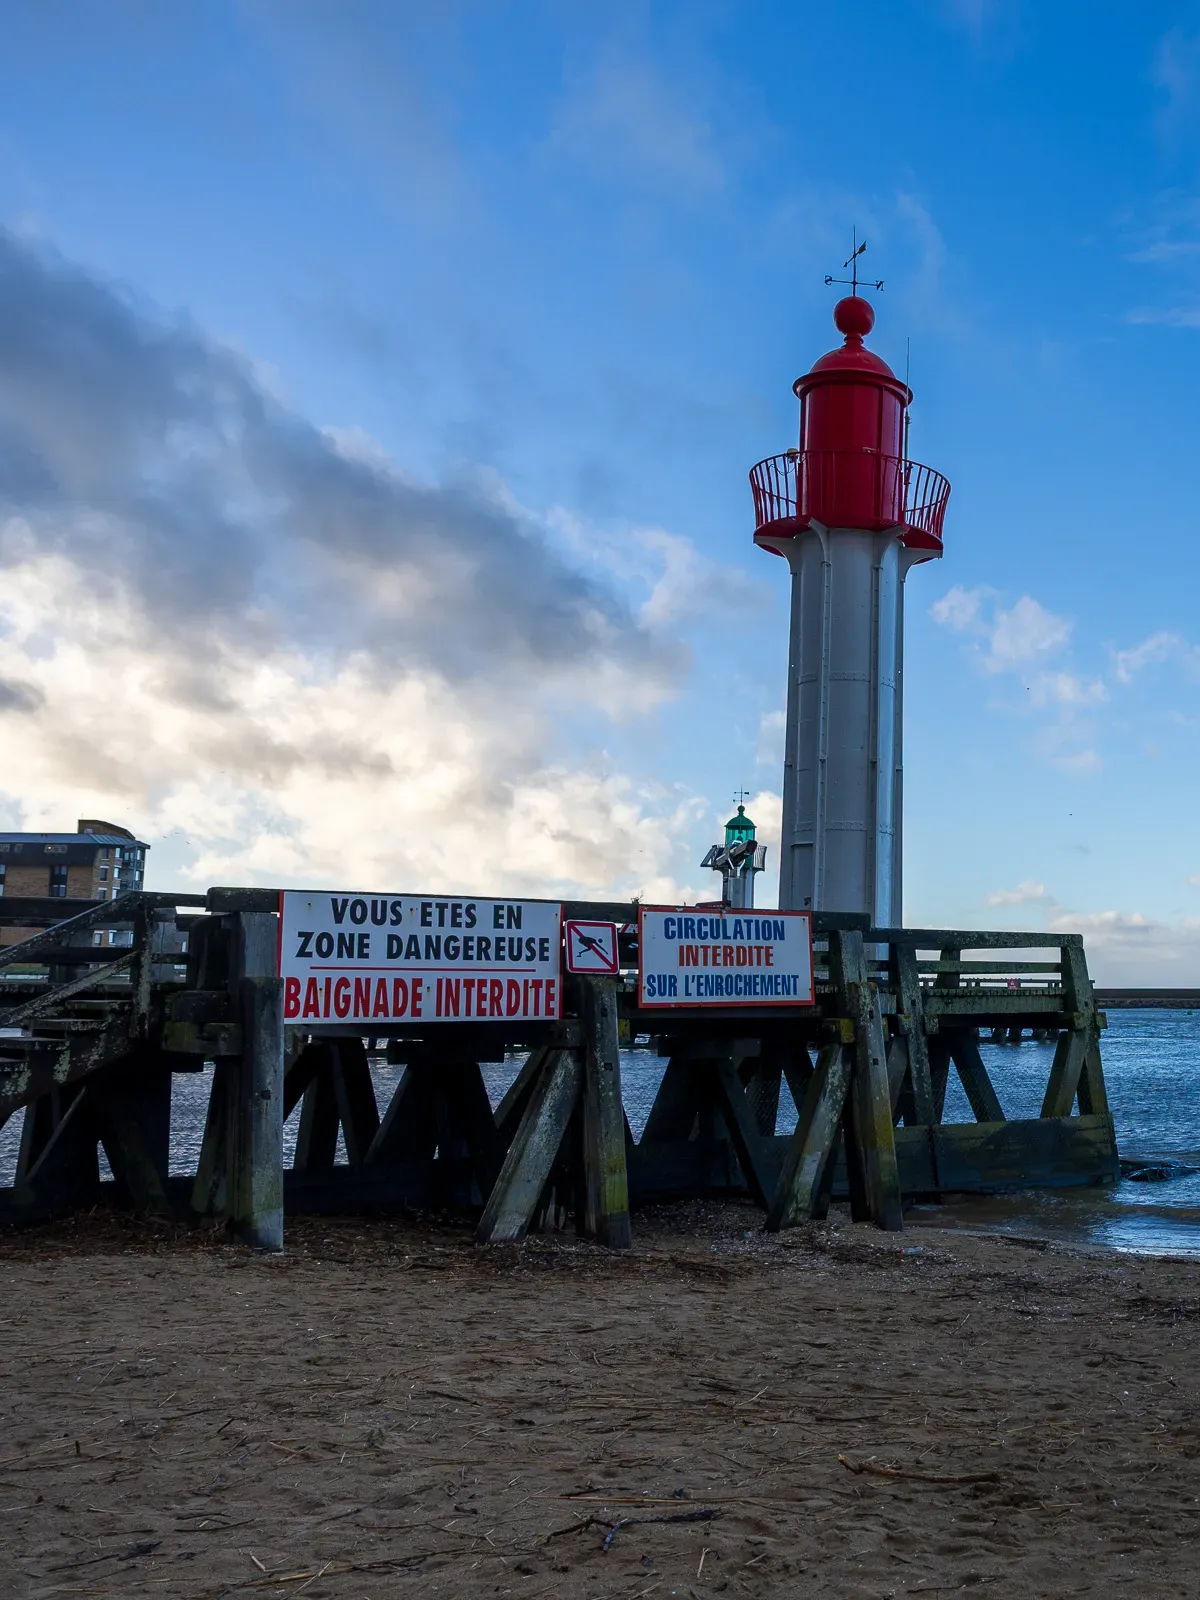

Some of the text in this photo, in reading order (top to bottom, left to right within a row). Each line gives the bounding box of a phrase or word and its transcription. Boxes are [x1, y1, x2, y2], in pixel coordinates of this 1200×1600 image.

[331, 898, 523, 930] VOUS ETES EN
[663, 917, 785, 941] CIRCULATION
[295, 931, 550, 962] ZONE DANGEREUSE
[678, 945, 774, 967] INTERDITE
[284, 977, 556, 1019] BAIGNADE INTERDITE
[647, 974, 799, 997] SUR L'ENROCHEMENT
